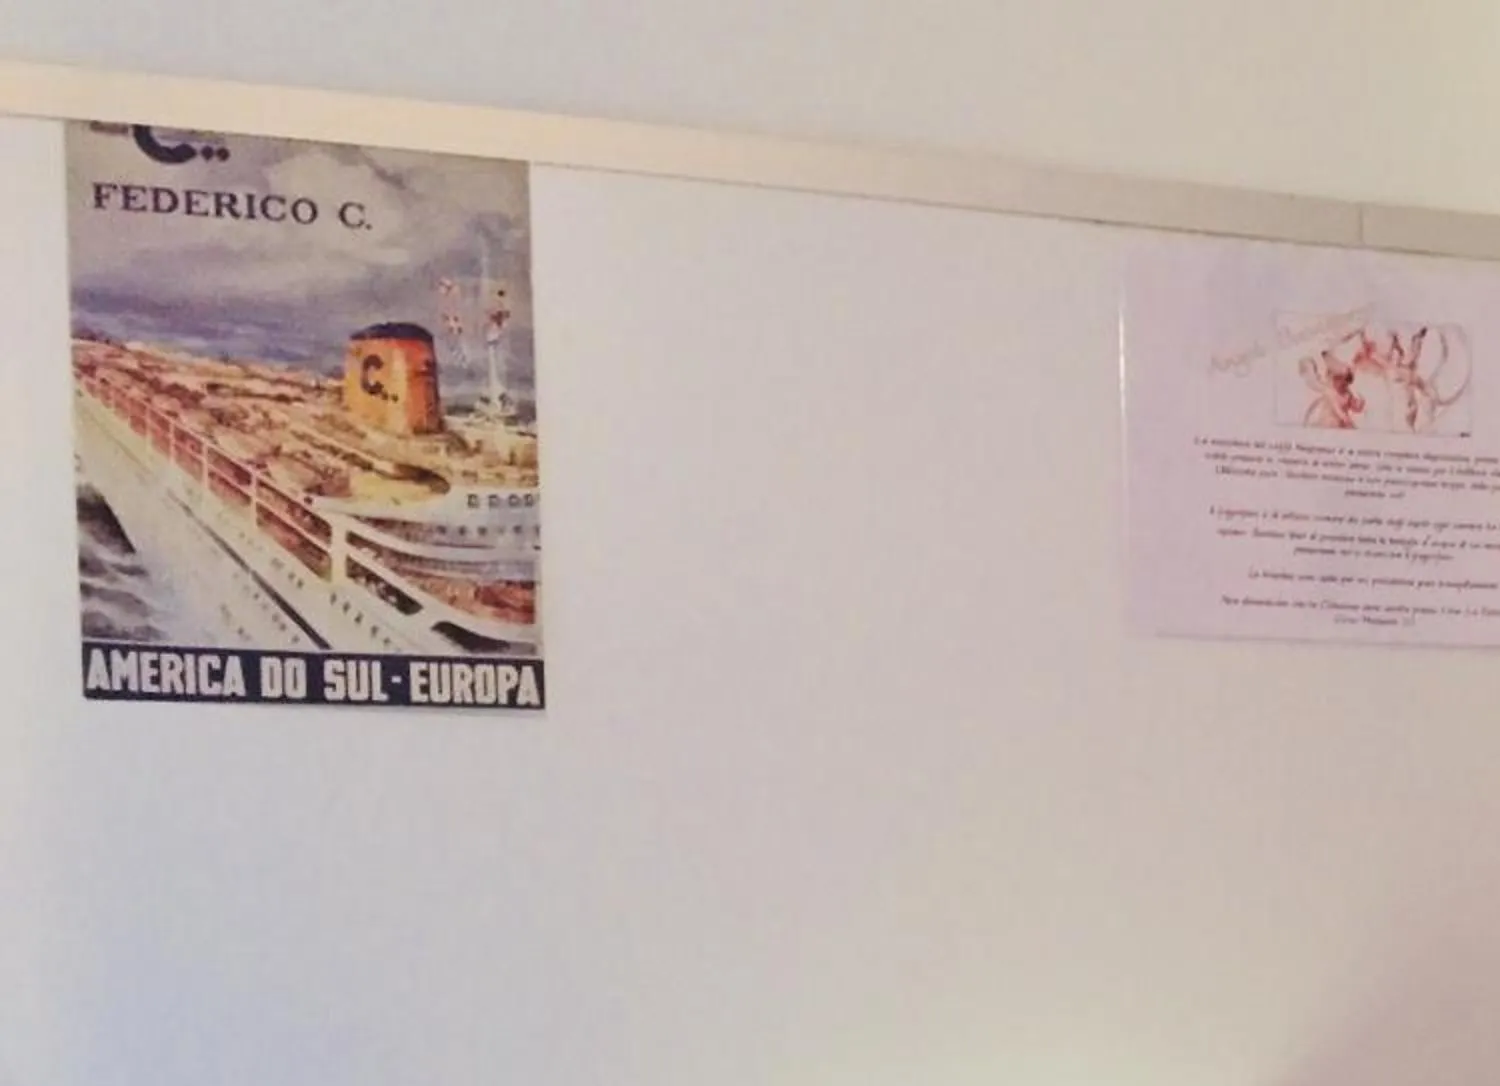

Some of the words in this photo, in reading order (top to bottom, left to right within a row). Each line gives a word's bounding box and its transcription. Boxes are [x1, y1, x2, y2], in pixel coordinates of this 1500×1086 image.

[92, 182, 318, 225] FEDERICO
[337, 200, 373, 231] C.
[86, 648, 247, 697] AMERICA
[259, 657, 307, 699] DO
